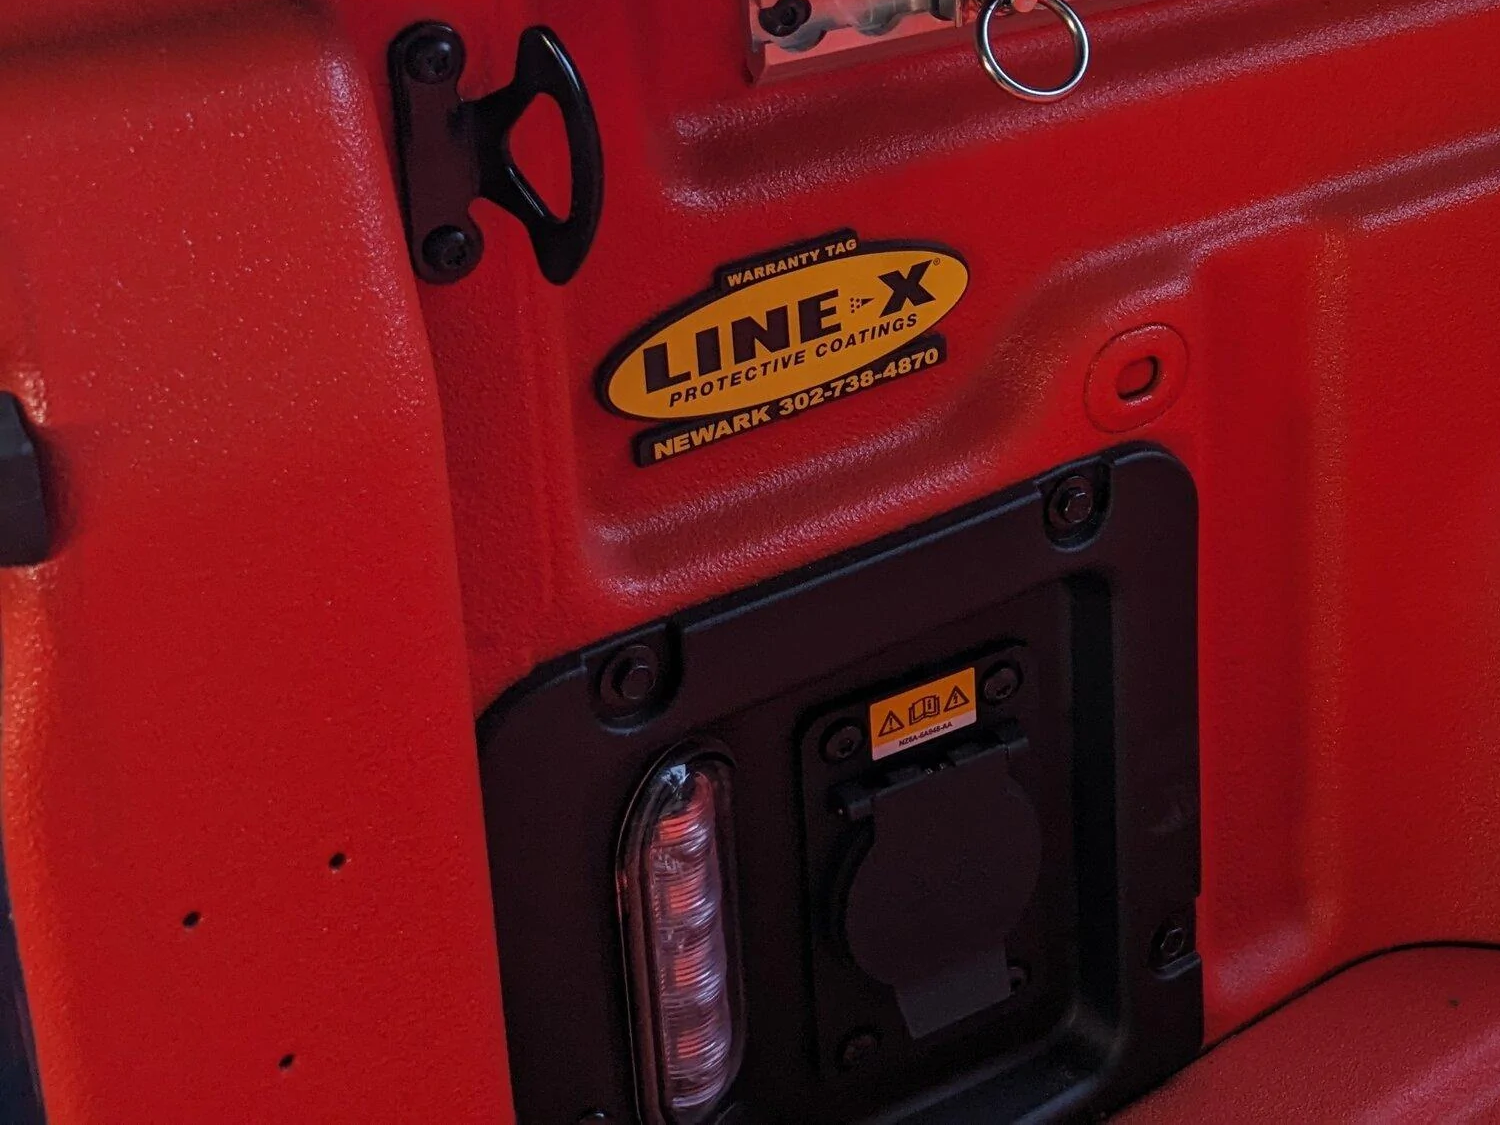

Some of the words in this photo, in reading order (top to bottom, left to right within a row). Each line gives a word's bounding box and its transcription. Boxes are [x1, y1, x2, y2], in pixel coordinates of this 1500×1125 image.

[727, 248, 820, 287] WARRANTY
[825, 238, 857, 258] TAG
[654, 405, 771, 460] NEWARK
[779, 348, 939, 416] 302-738-4870
[669, 350, 806, 407] PROTECTIVE
[815, 313, 918, 358] COATINGS
